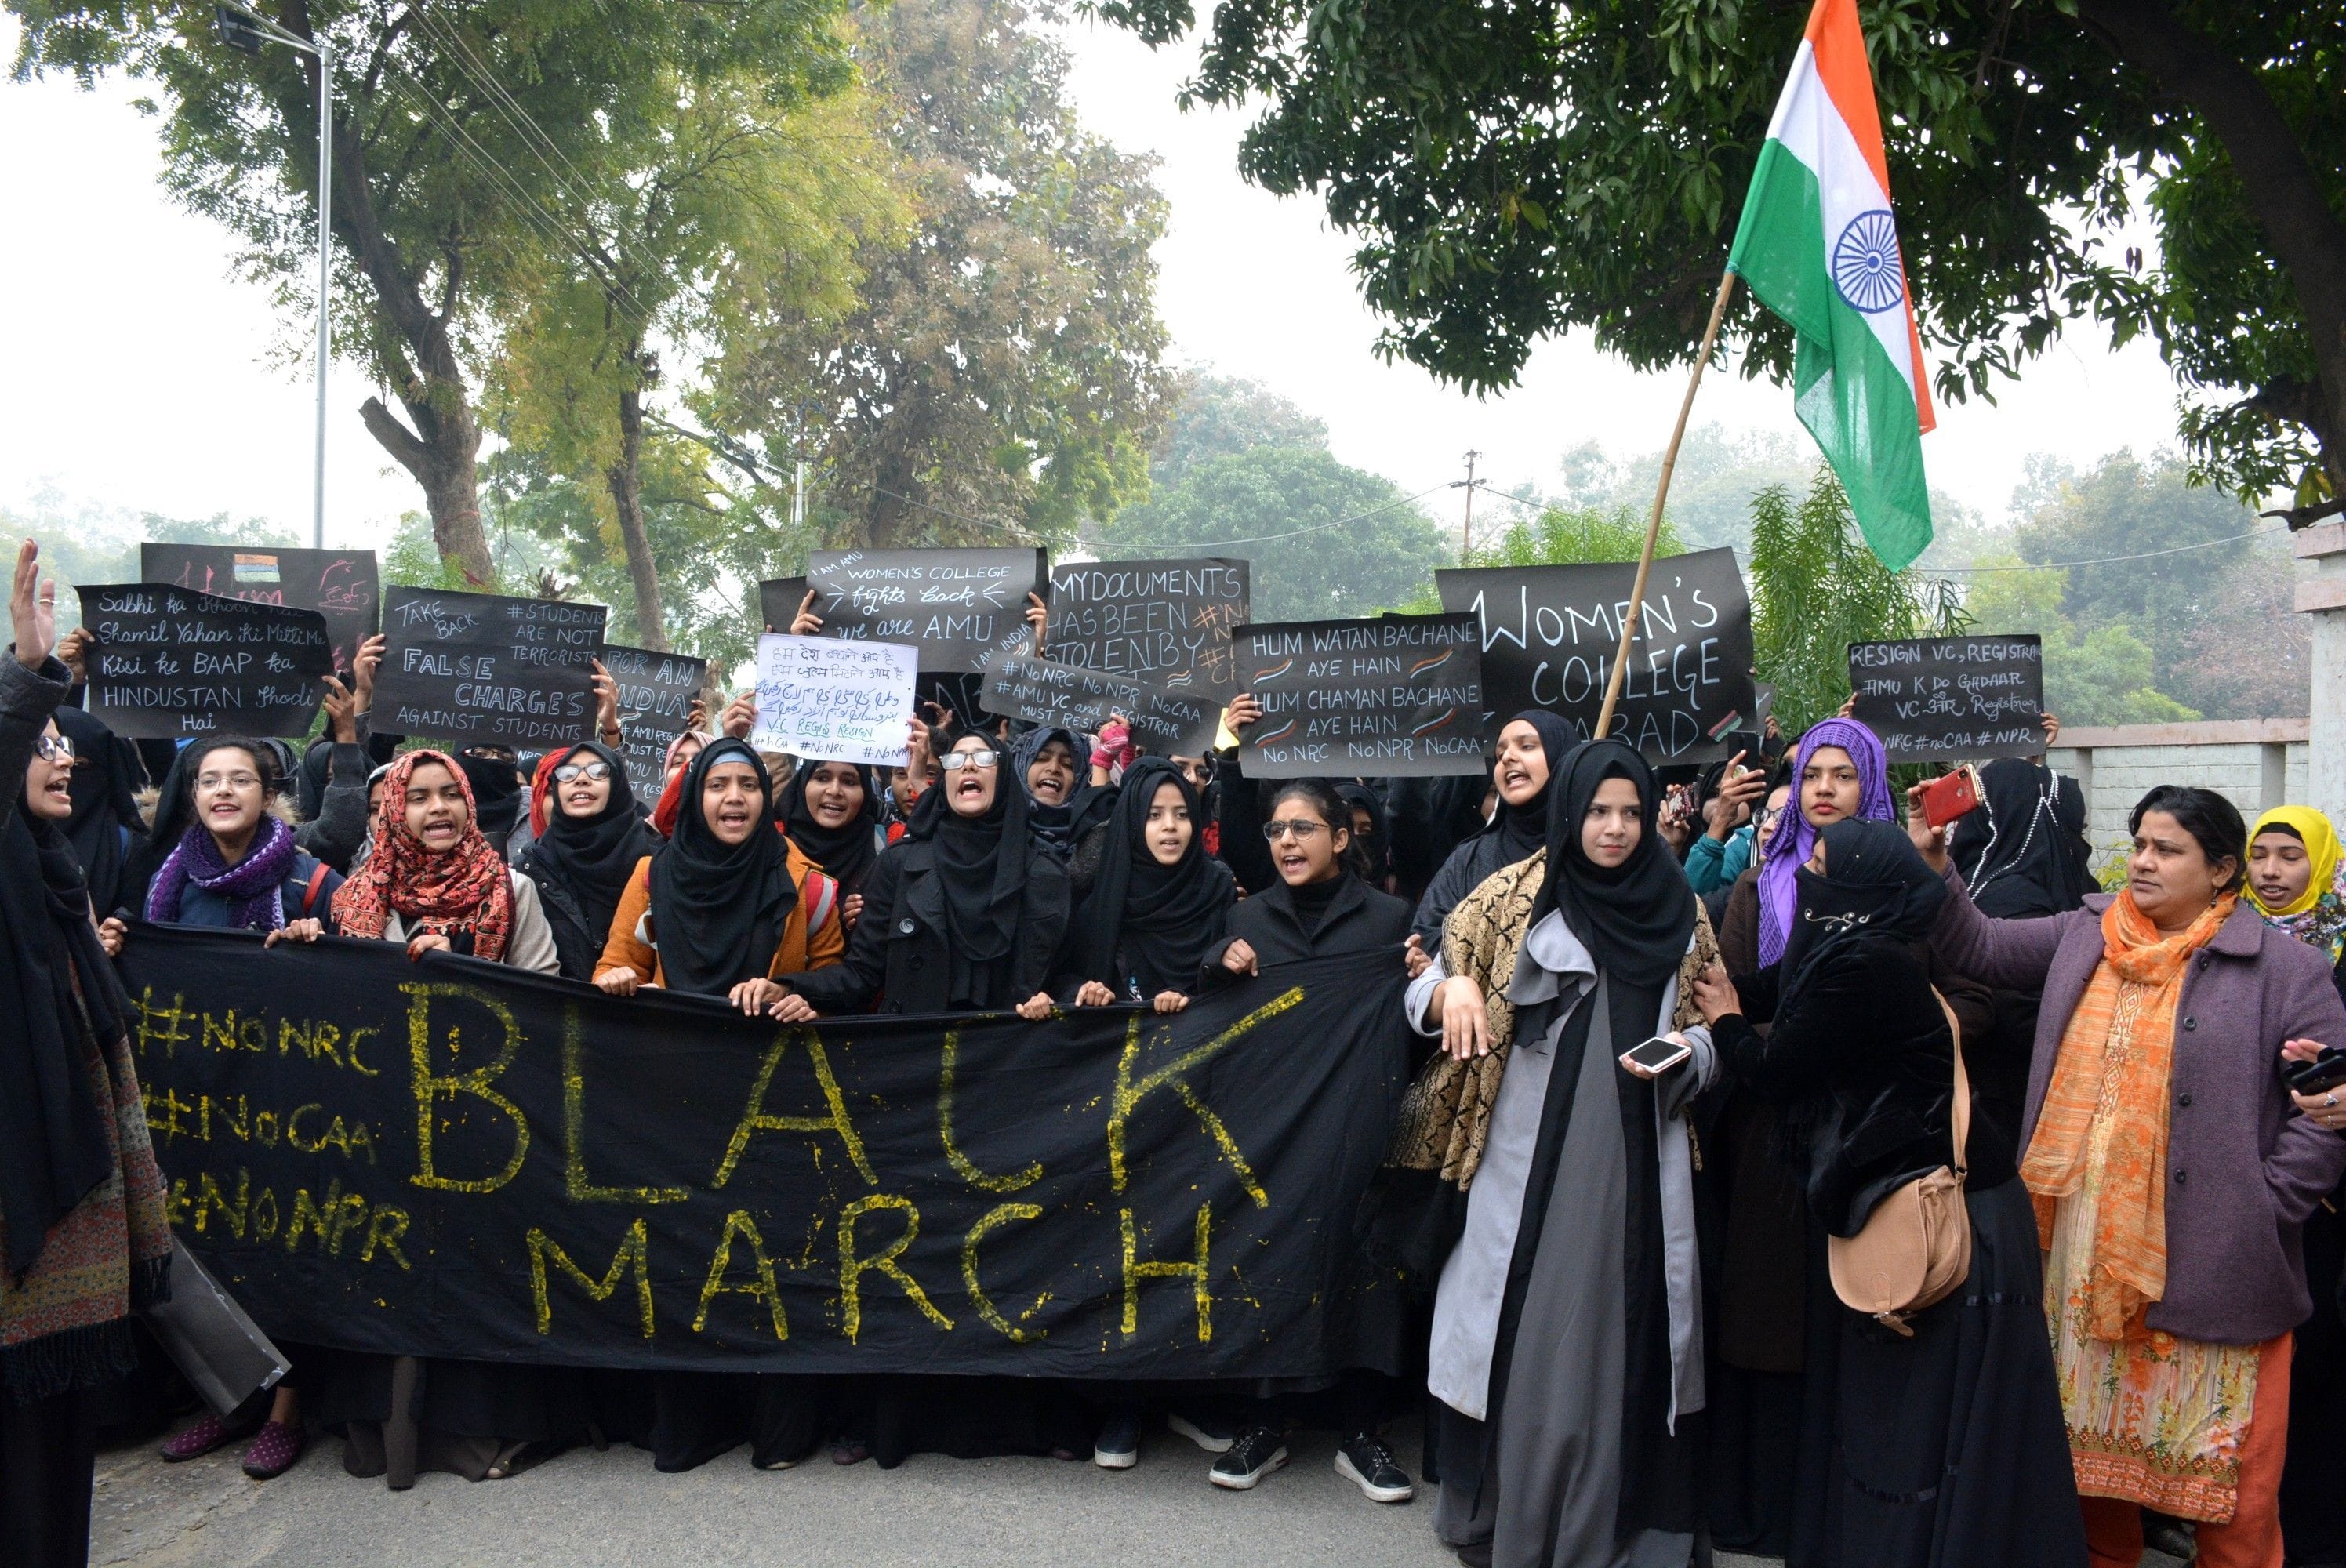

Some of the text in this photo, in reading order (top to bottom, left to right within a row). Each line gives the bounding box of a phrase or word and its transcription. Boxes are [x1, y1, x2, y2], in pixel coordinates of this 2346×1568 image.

[821, 561, 839, 575] AM
[842, 550, 863, 568] AMU
[848, 566, 1011, 580] WOMEN'S COLLEGE
[99, 591, 156, 614] Sabhi
[852, 585, 975, 615] fights back
[395, 600, 479, 640] TAKE BACK
[507, 603, 605, 625] #STUDENTS
[1470, 575, 1718, 653] WOMEN'S
[176, 621, 233, 644] Yahan
[515, 625, 598, 646] ARE NOT
[877, 619, 914, 636] are
[923, 615, 993, 641] AMU
[1000, 623, 1032, 651] INDIA
[1253, 632, 1302, 657] HUM
[1313, 627, 1378, 652] WATAN
[1383, 622, 1477, 648] BACHANE
[103, 655, 146, 677] Kisi
[194, 652, 252, 675] BAAP
[264, 651, 296, 673] ka
[403, 648, 496, 680] FALSE
[511, 645, 598, 666] TERRORISTS
[1308, 656, 1400, 677] AYE HAIN
[1851, 644, 1921, 666] RESIGN
[606, 650, 695, 687] FOR AN
[1532, 637, 1720, 710] COLLEGE
[104, 685, 241, 708] HINDUSTAN
[1255, 685, 1479, 713] HUM CHAMAN BACHANE
[1863, 680, 1901, 696] AMU
[1914, 676, 1927, 695] K
[455, 683, 585, 717] CHARGES
[616, 684, 687, 720] NDIA
[1051, 691, 1070, 709] VC
[1075, 700, 1101, 717] and
[1895, 700, 1919, 720] VC
[1970, 692, 2043, 721] Registrar
[182, 713, 216, 731] Hai
[396, 706, 582, 741] AGAINST STUDENTS
[837, 723, 873, 739] RESIGN
[1020, 704, 1102, 733] MUST RESIG
[1306, 714, 1397, 737] AYE HAIN
[398, 982, 1305, 1208] BLACK
[526, 1194, 1212, 1345] MARCH
